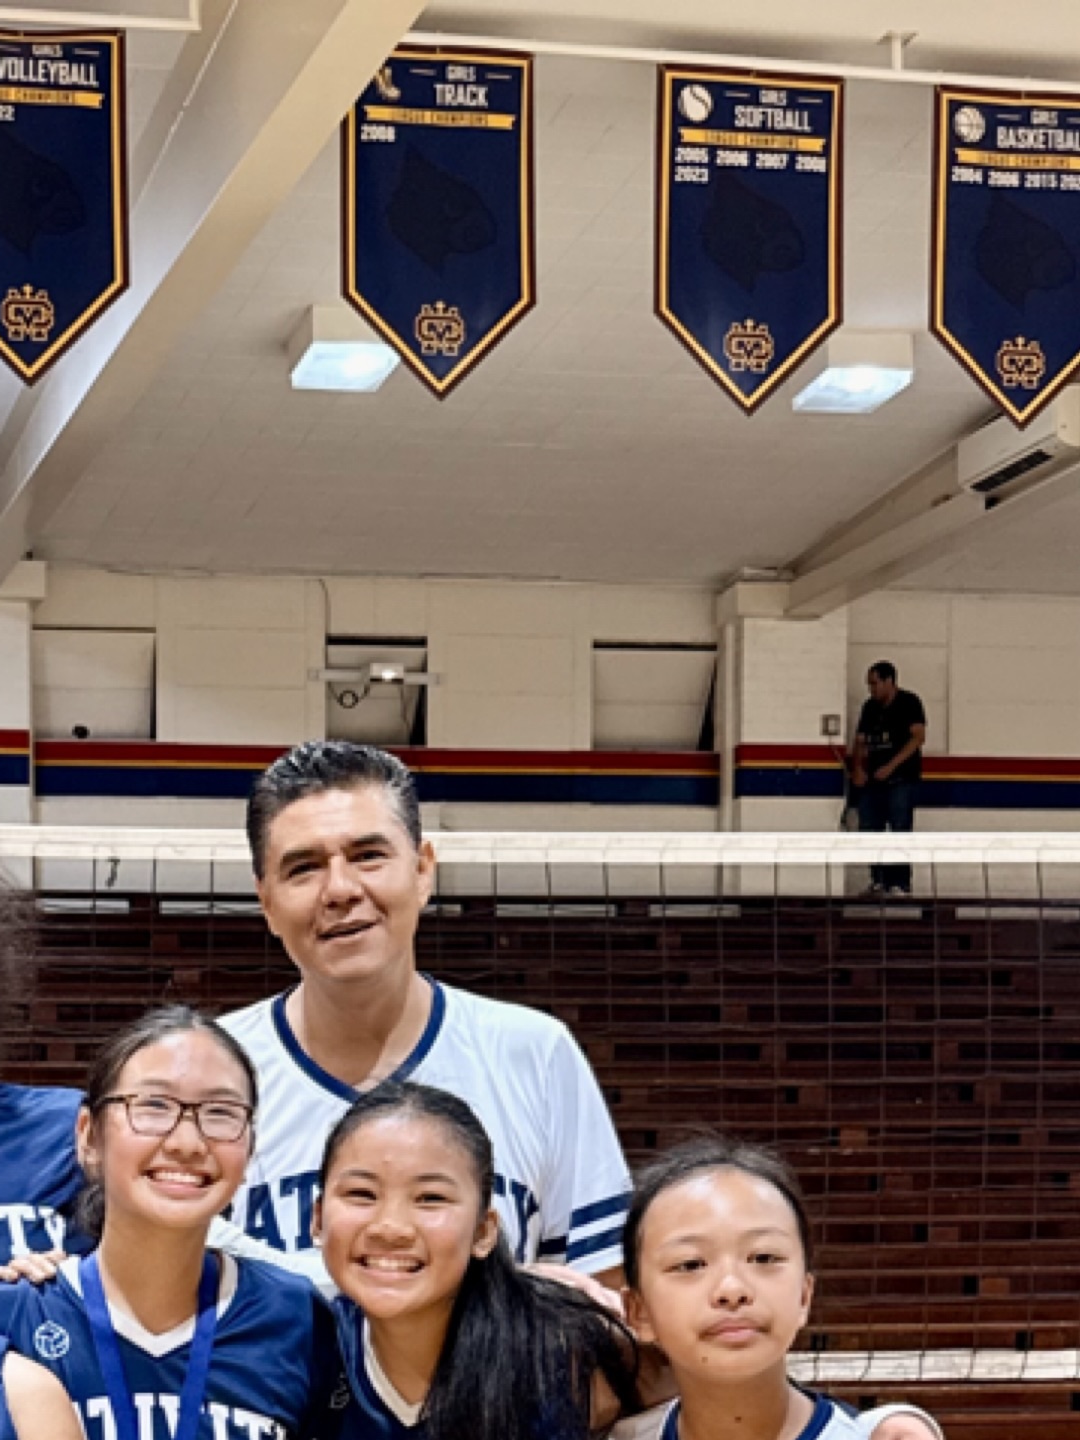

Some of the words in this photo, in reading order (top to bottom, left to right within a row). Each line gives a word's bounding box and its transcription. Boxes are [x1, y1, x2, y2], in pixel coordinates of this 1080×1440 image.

[434, 83, 488, 108] TRACK
[734, 105, 812, 133] SOFTBALL
[997, 126, 1080, 152] BASKETBAL
